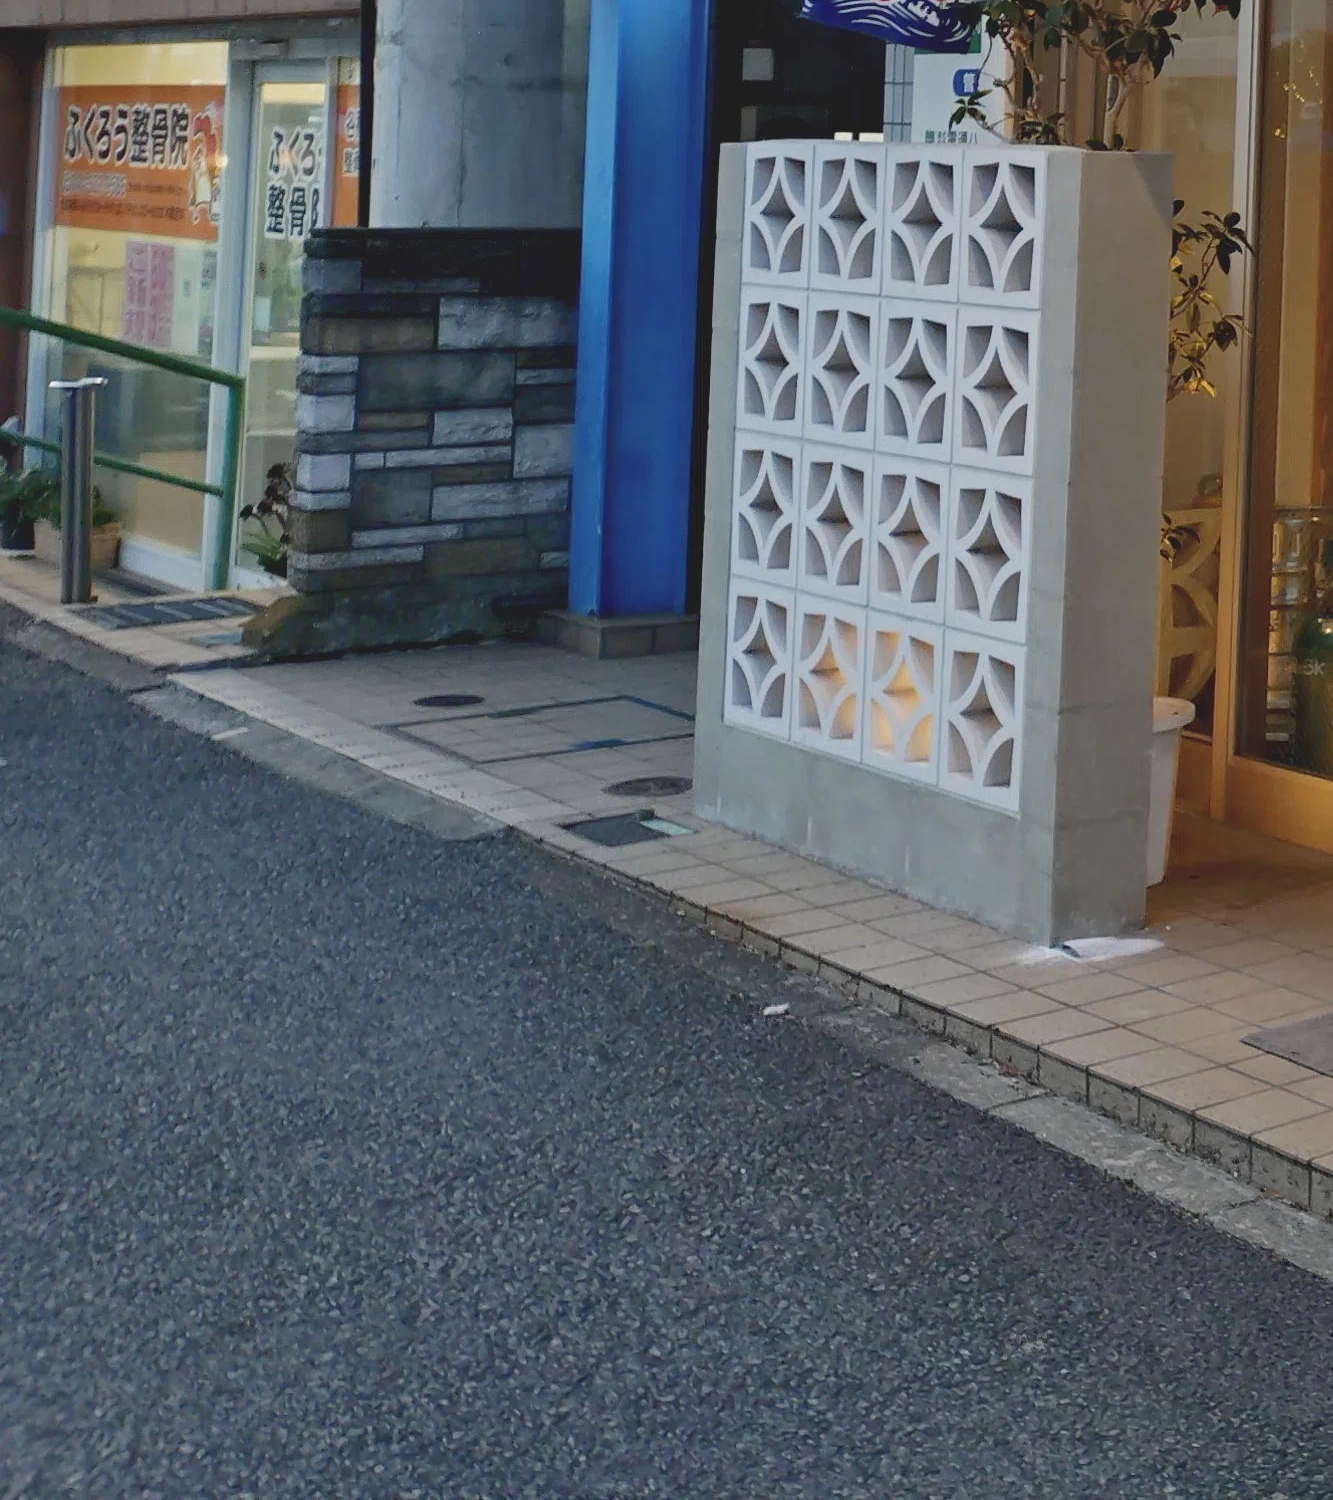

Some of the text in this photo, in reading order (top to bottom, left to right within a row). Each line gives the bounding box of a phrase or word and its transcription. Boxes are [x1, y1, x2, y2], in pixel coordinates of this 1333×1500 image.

[65, 104, 190, 168] ふくろう整骨院
[268, 127, 323, 180] ふくろ
